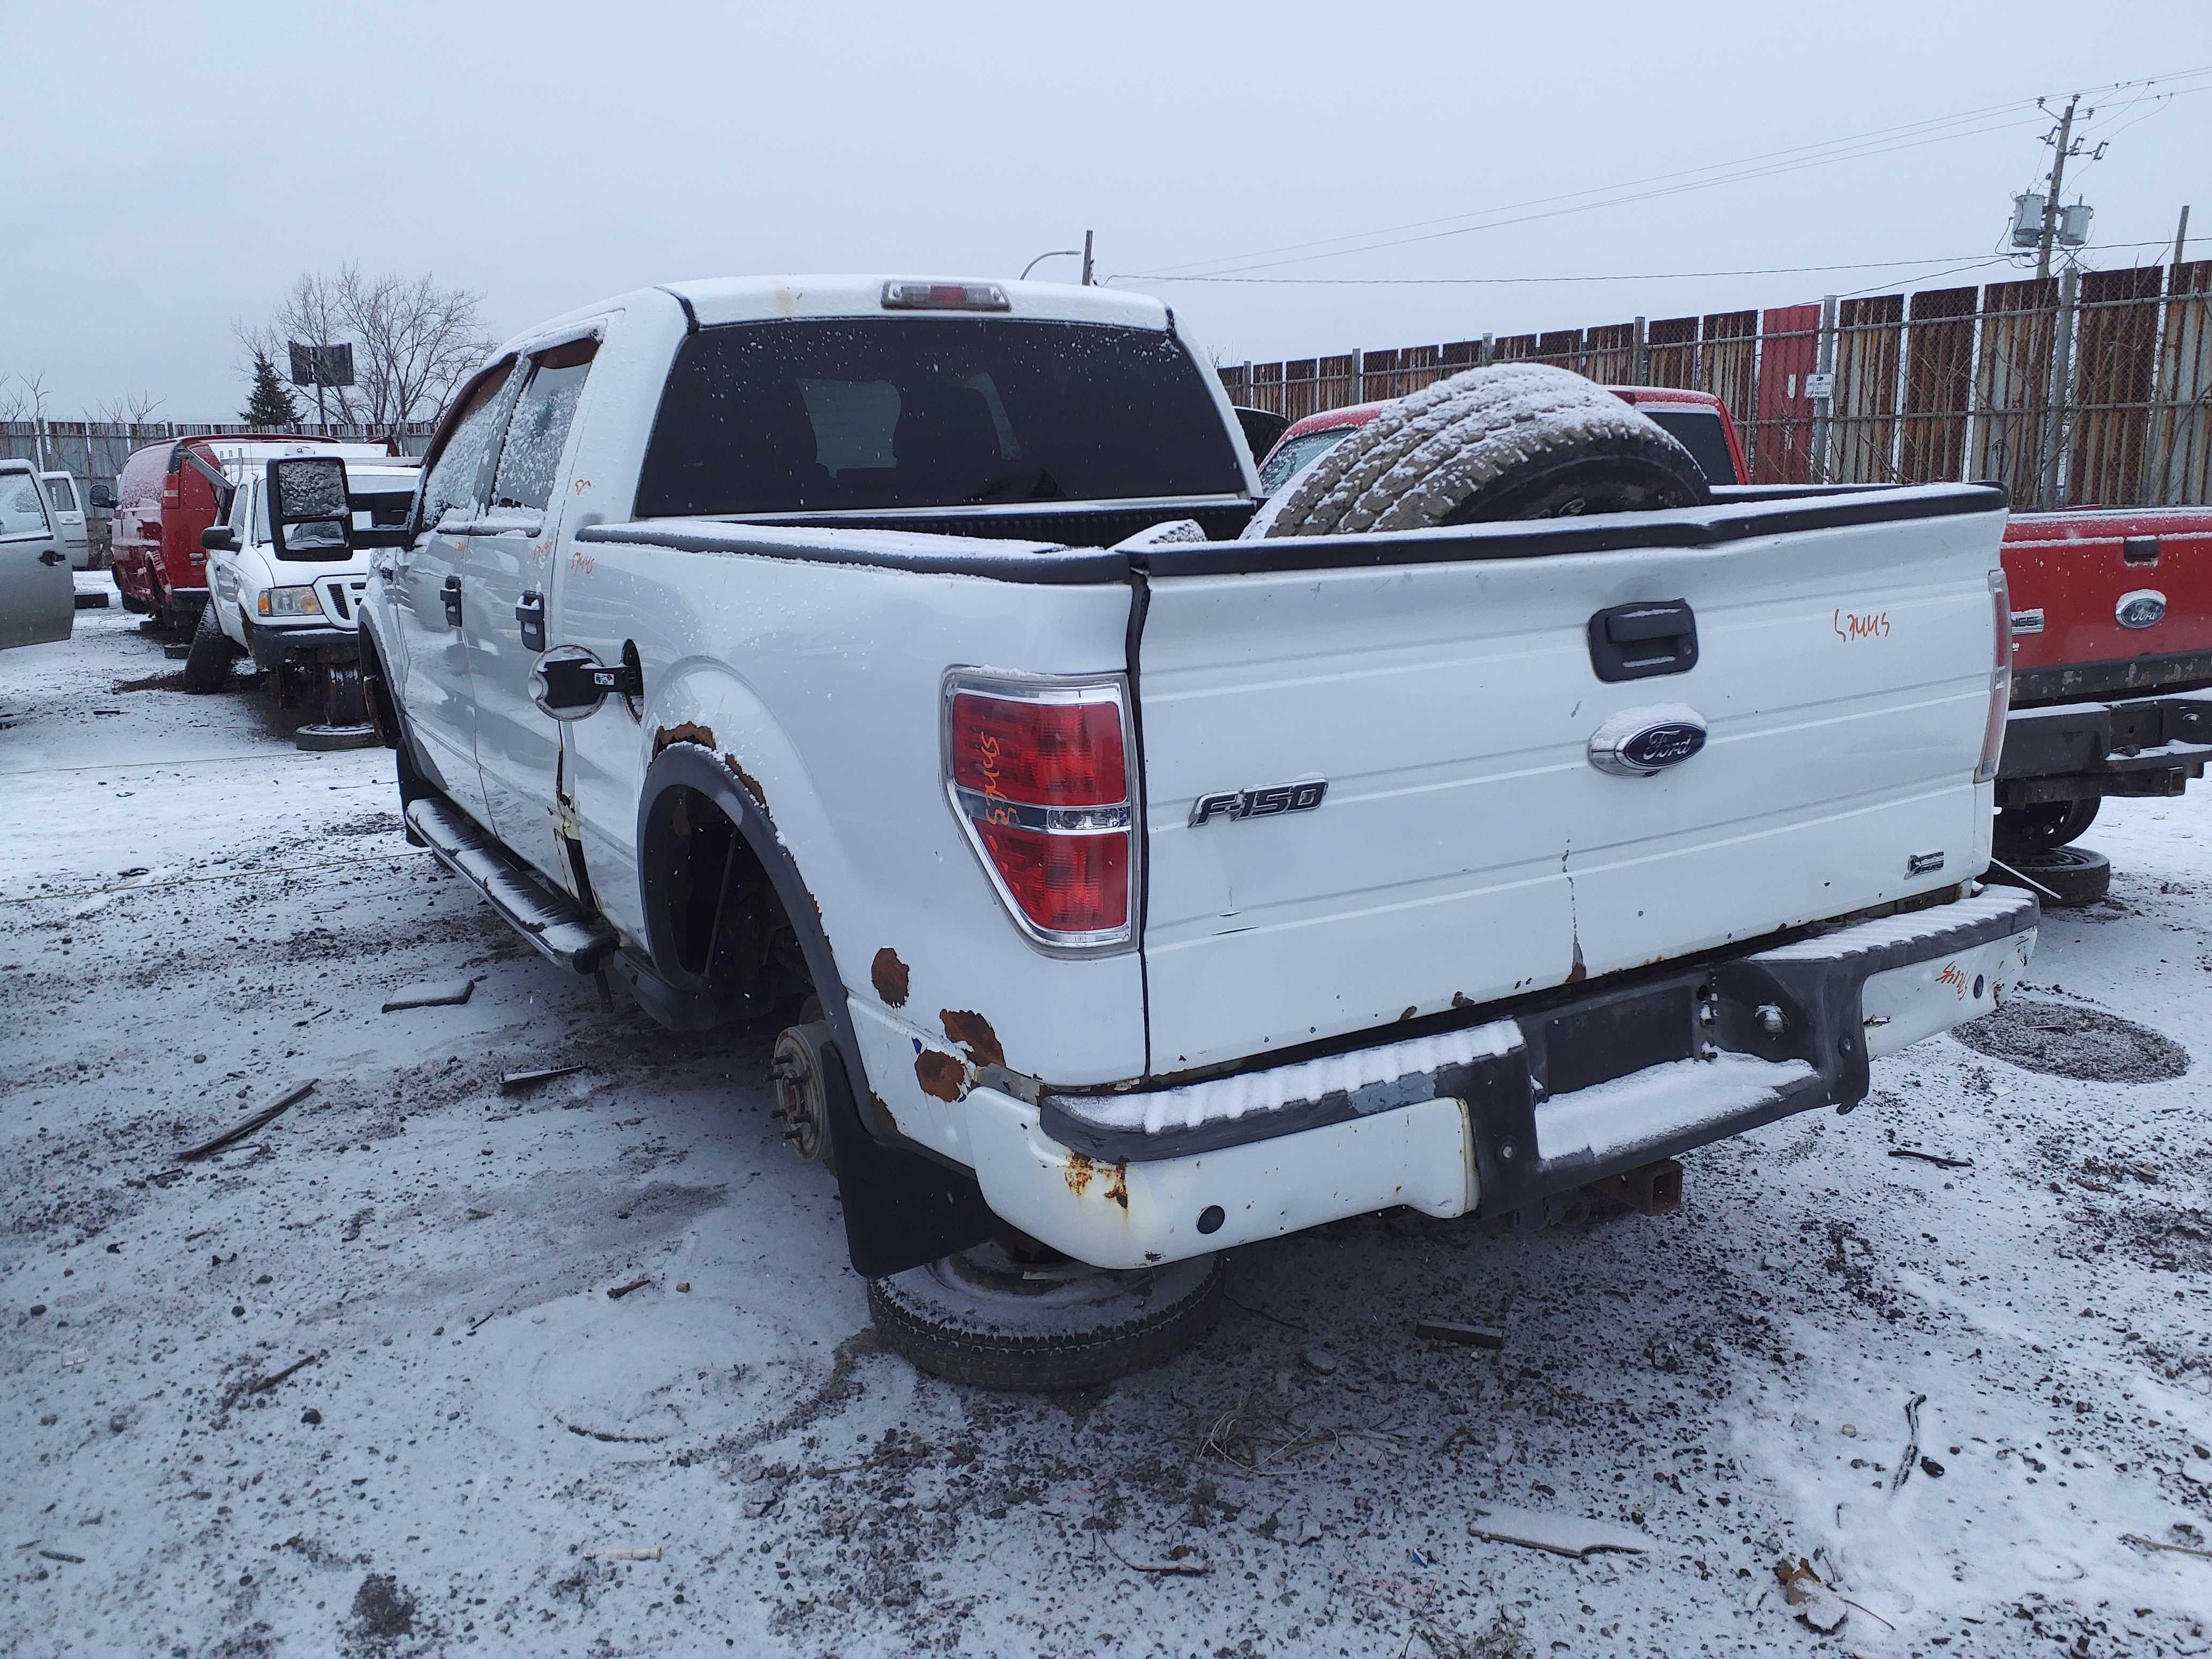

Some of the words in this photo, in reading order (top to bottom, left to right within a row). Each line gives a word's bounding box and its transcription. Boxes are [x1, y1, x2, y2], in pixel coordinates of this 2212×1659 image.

[2131, 603, 2159, 622] Ford
[1643, 729, 1693, 760] Ford
[1187, 778, 1329, 828] F-150
